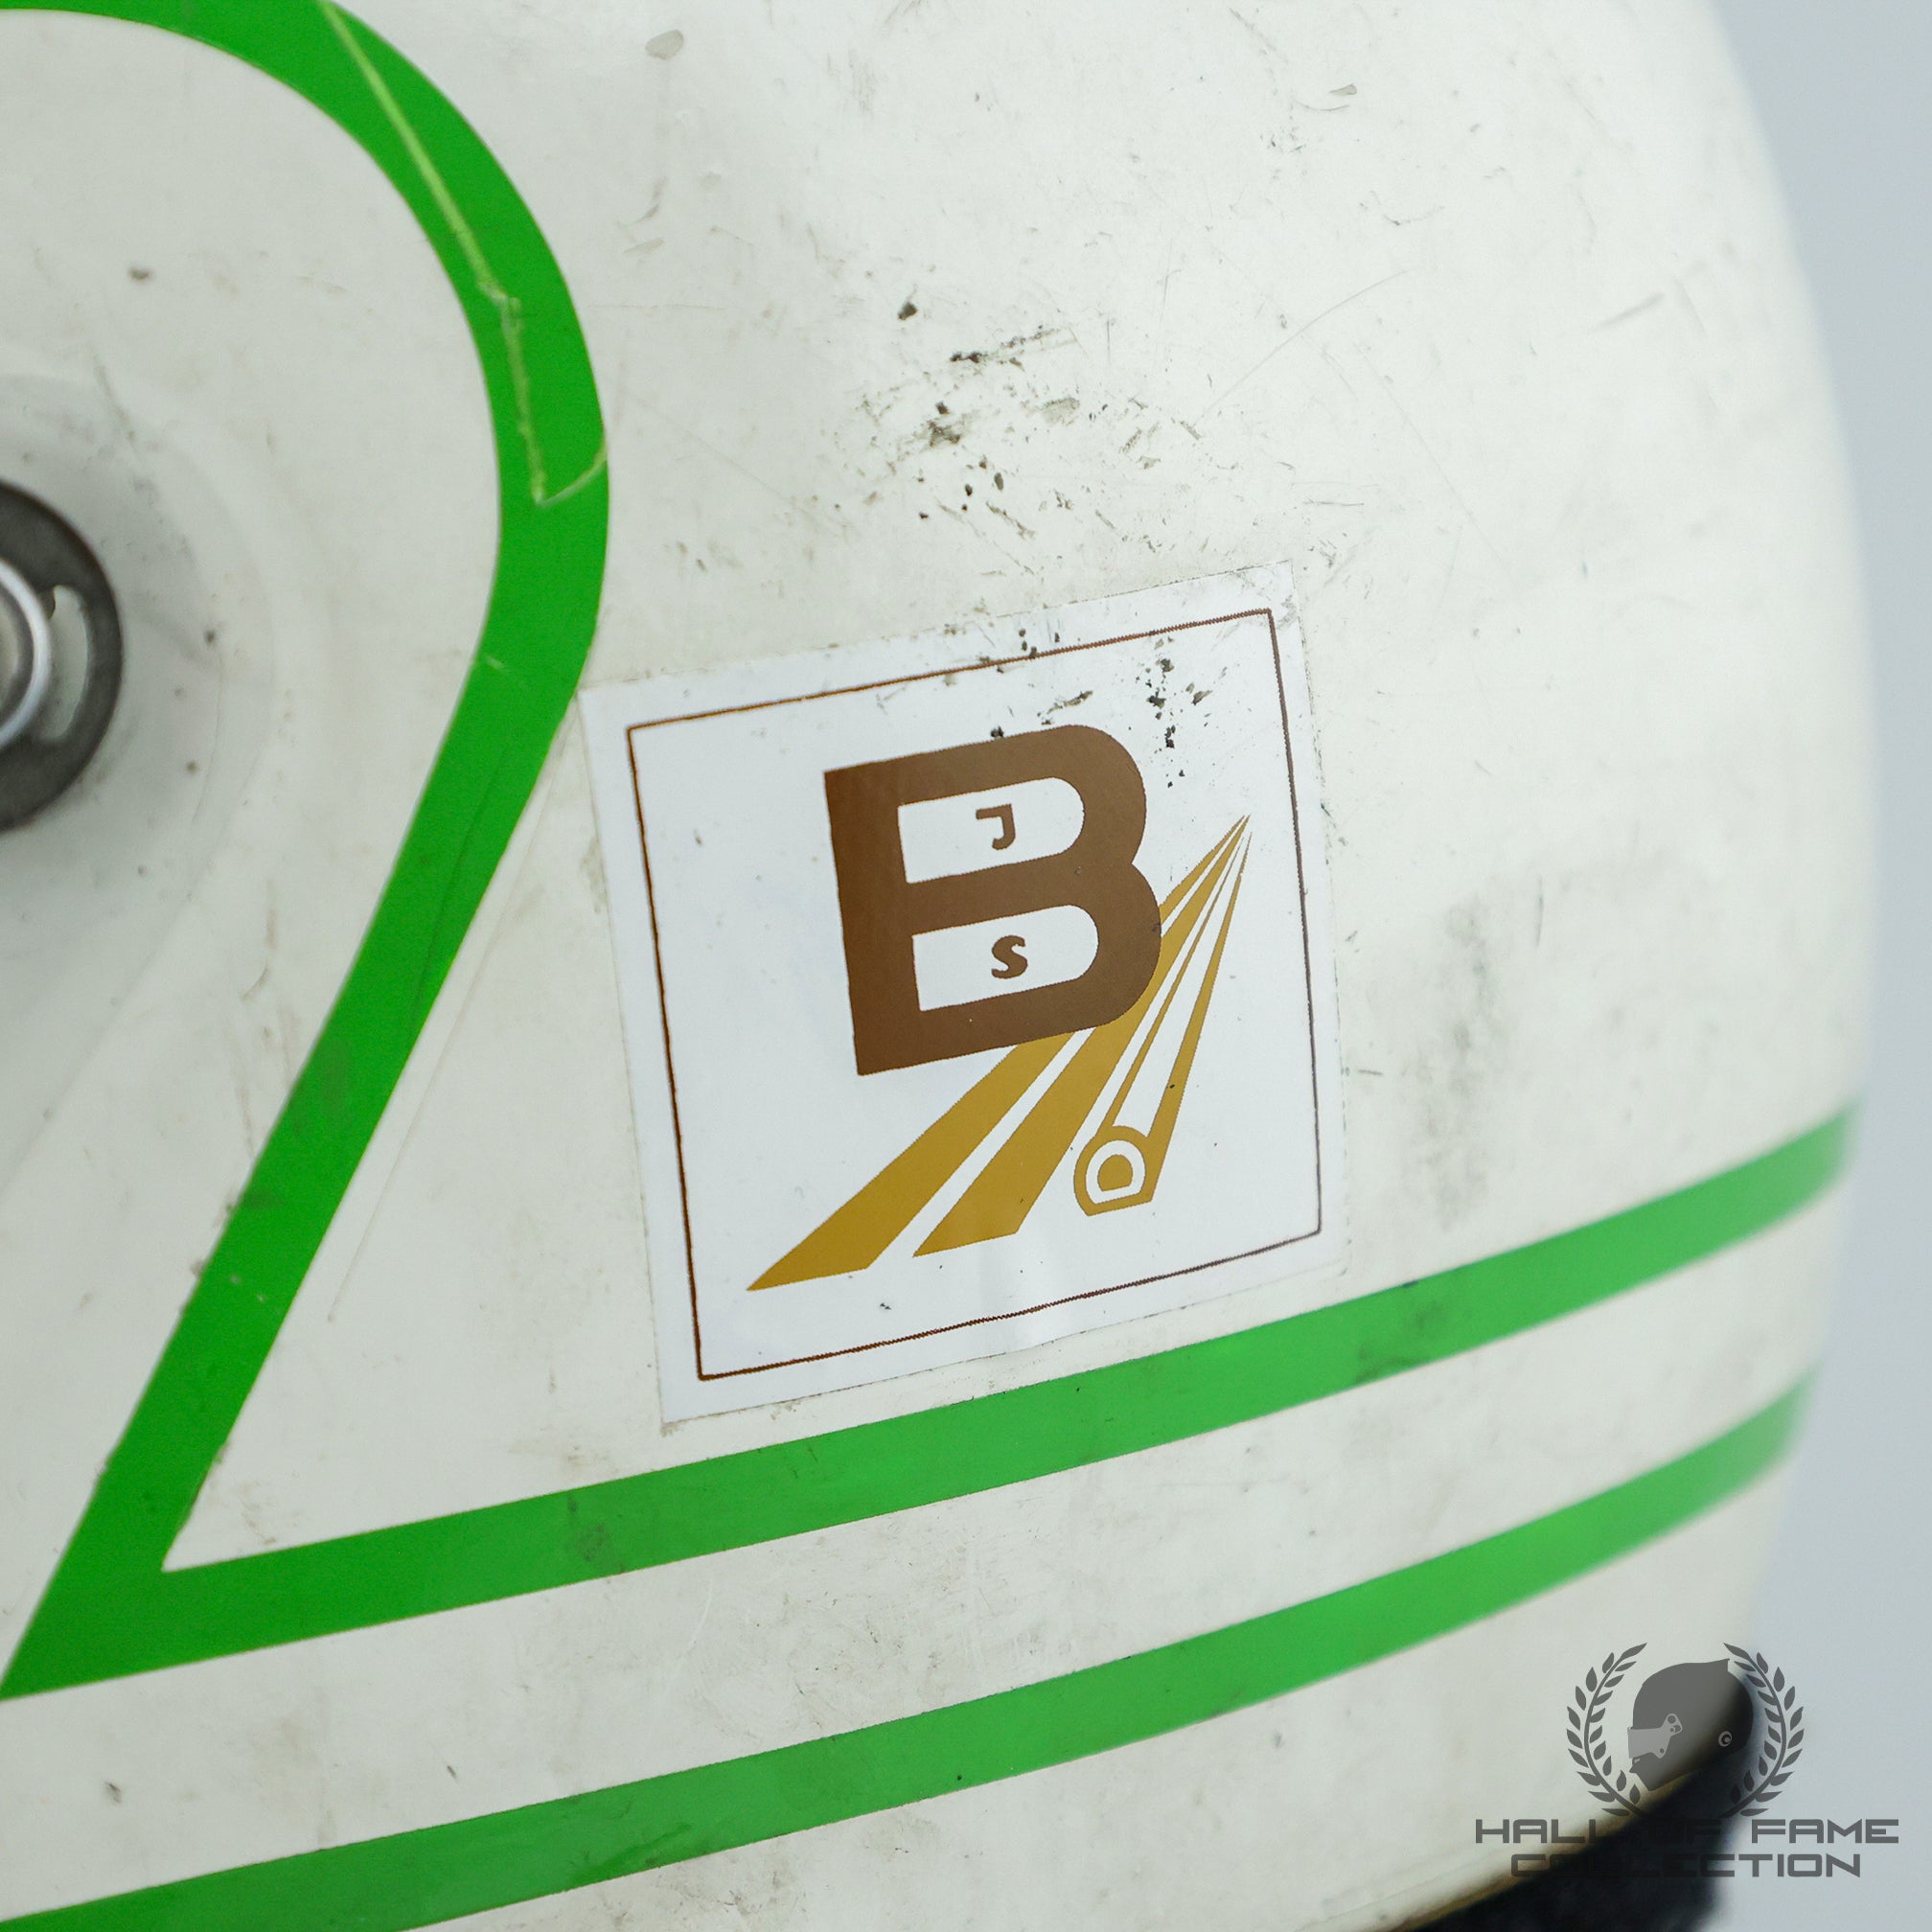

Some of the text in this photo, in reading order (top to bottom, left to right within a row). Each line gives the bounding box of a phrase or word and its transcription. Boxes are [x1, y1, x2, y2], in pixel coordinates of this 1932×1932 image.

[976, 803, 1016, 851] J
[824, 724, 1162, 1076] B
[991, 935, 1029, 979] S
